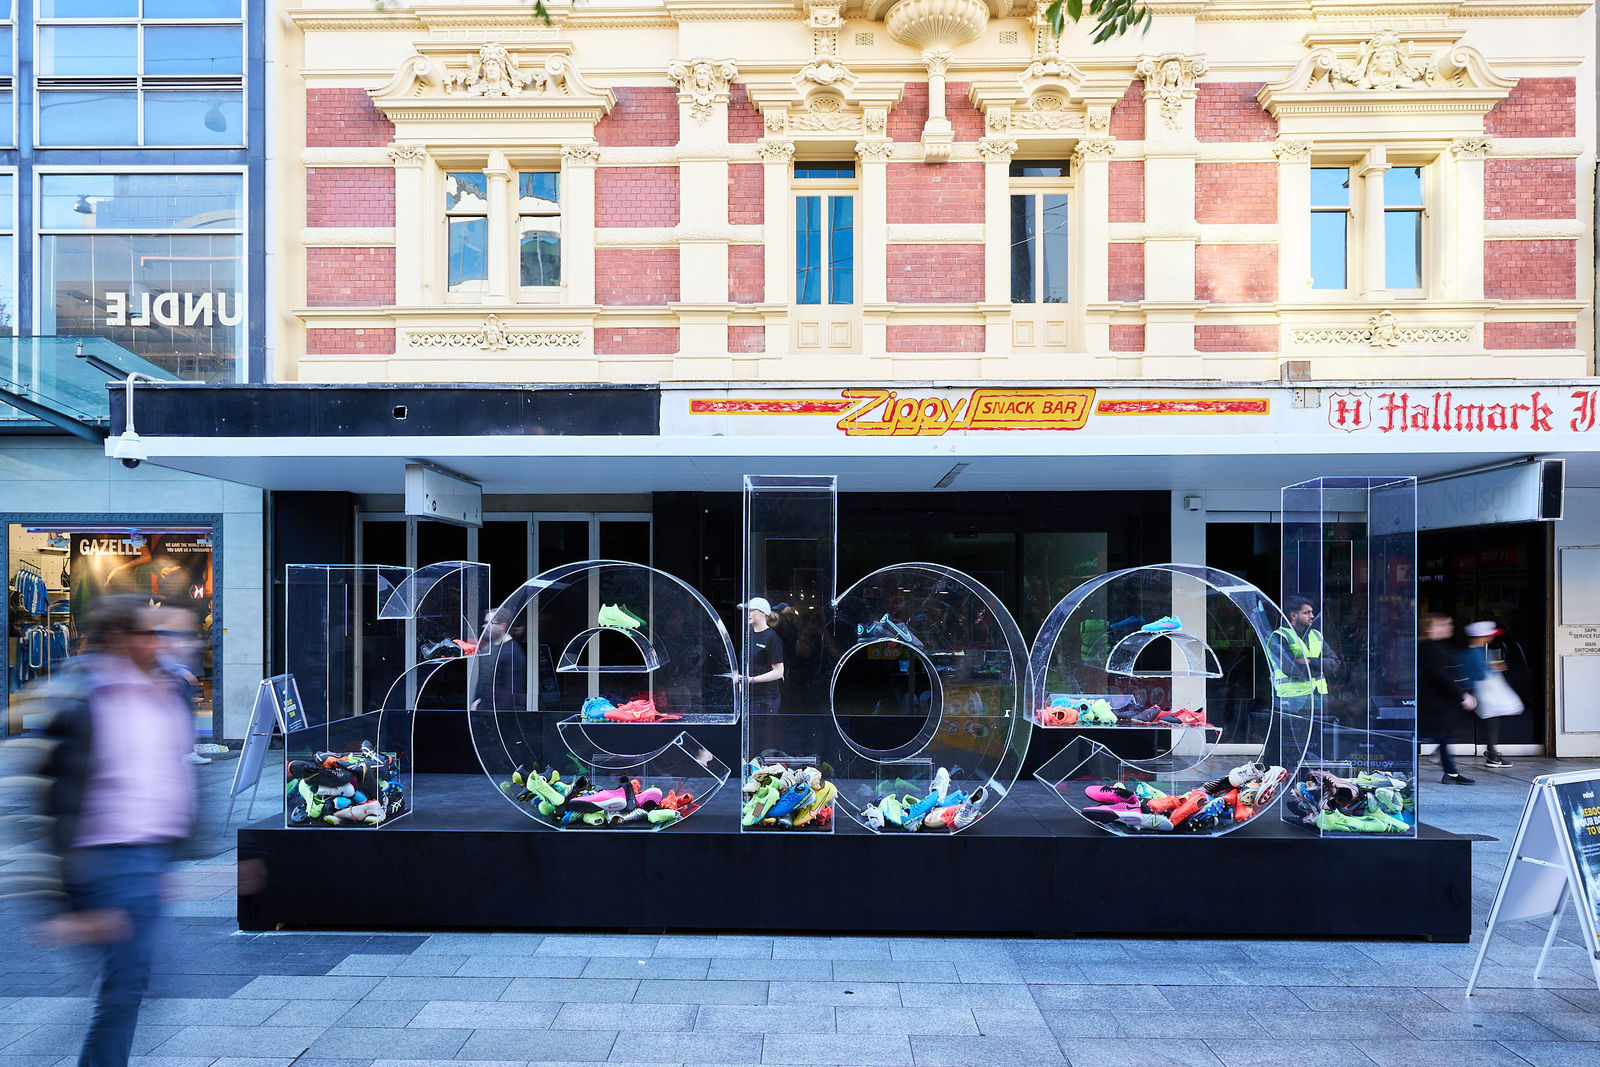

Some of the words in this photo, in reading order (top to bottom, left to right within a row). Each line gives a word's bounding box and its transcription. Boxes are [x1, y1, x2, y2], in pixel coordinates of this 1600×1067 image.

[837, 388, 967, 436] Zippy
[982, 400, 1035, 415] SNACK
[1041, 400, 1077, 415] BAR
[1377, 390, 1554, 433] Hallmark
[1440, 481, 1521, 517] Nelson
[79, 538, 142, 556] GAZELLE
[1586, 826, 1597, 836] TO
